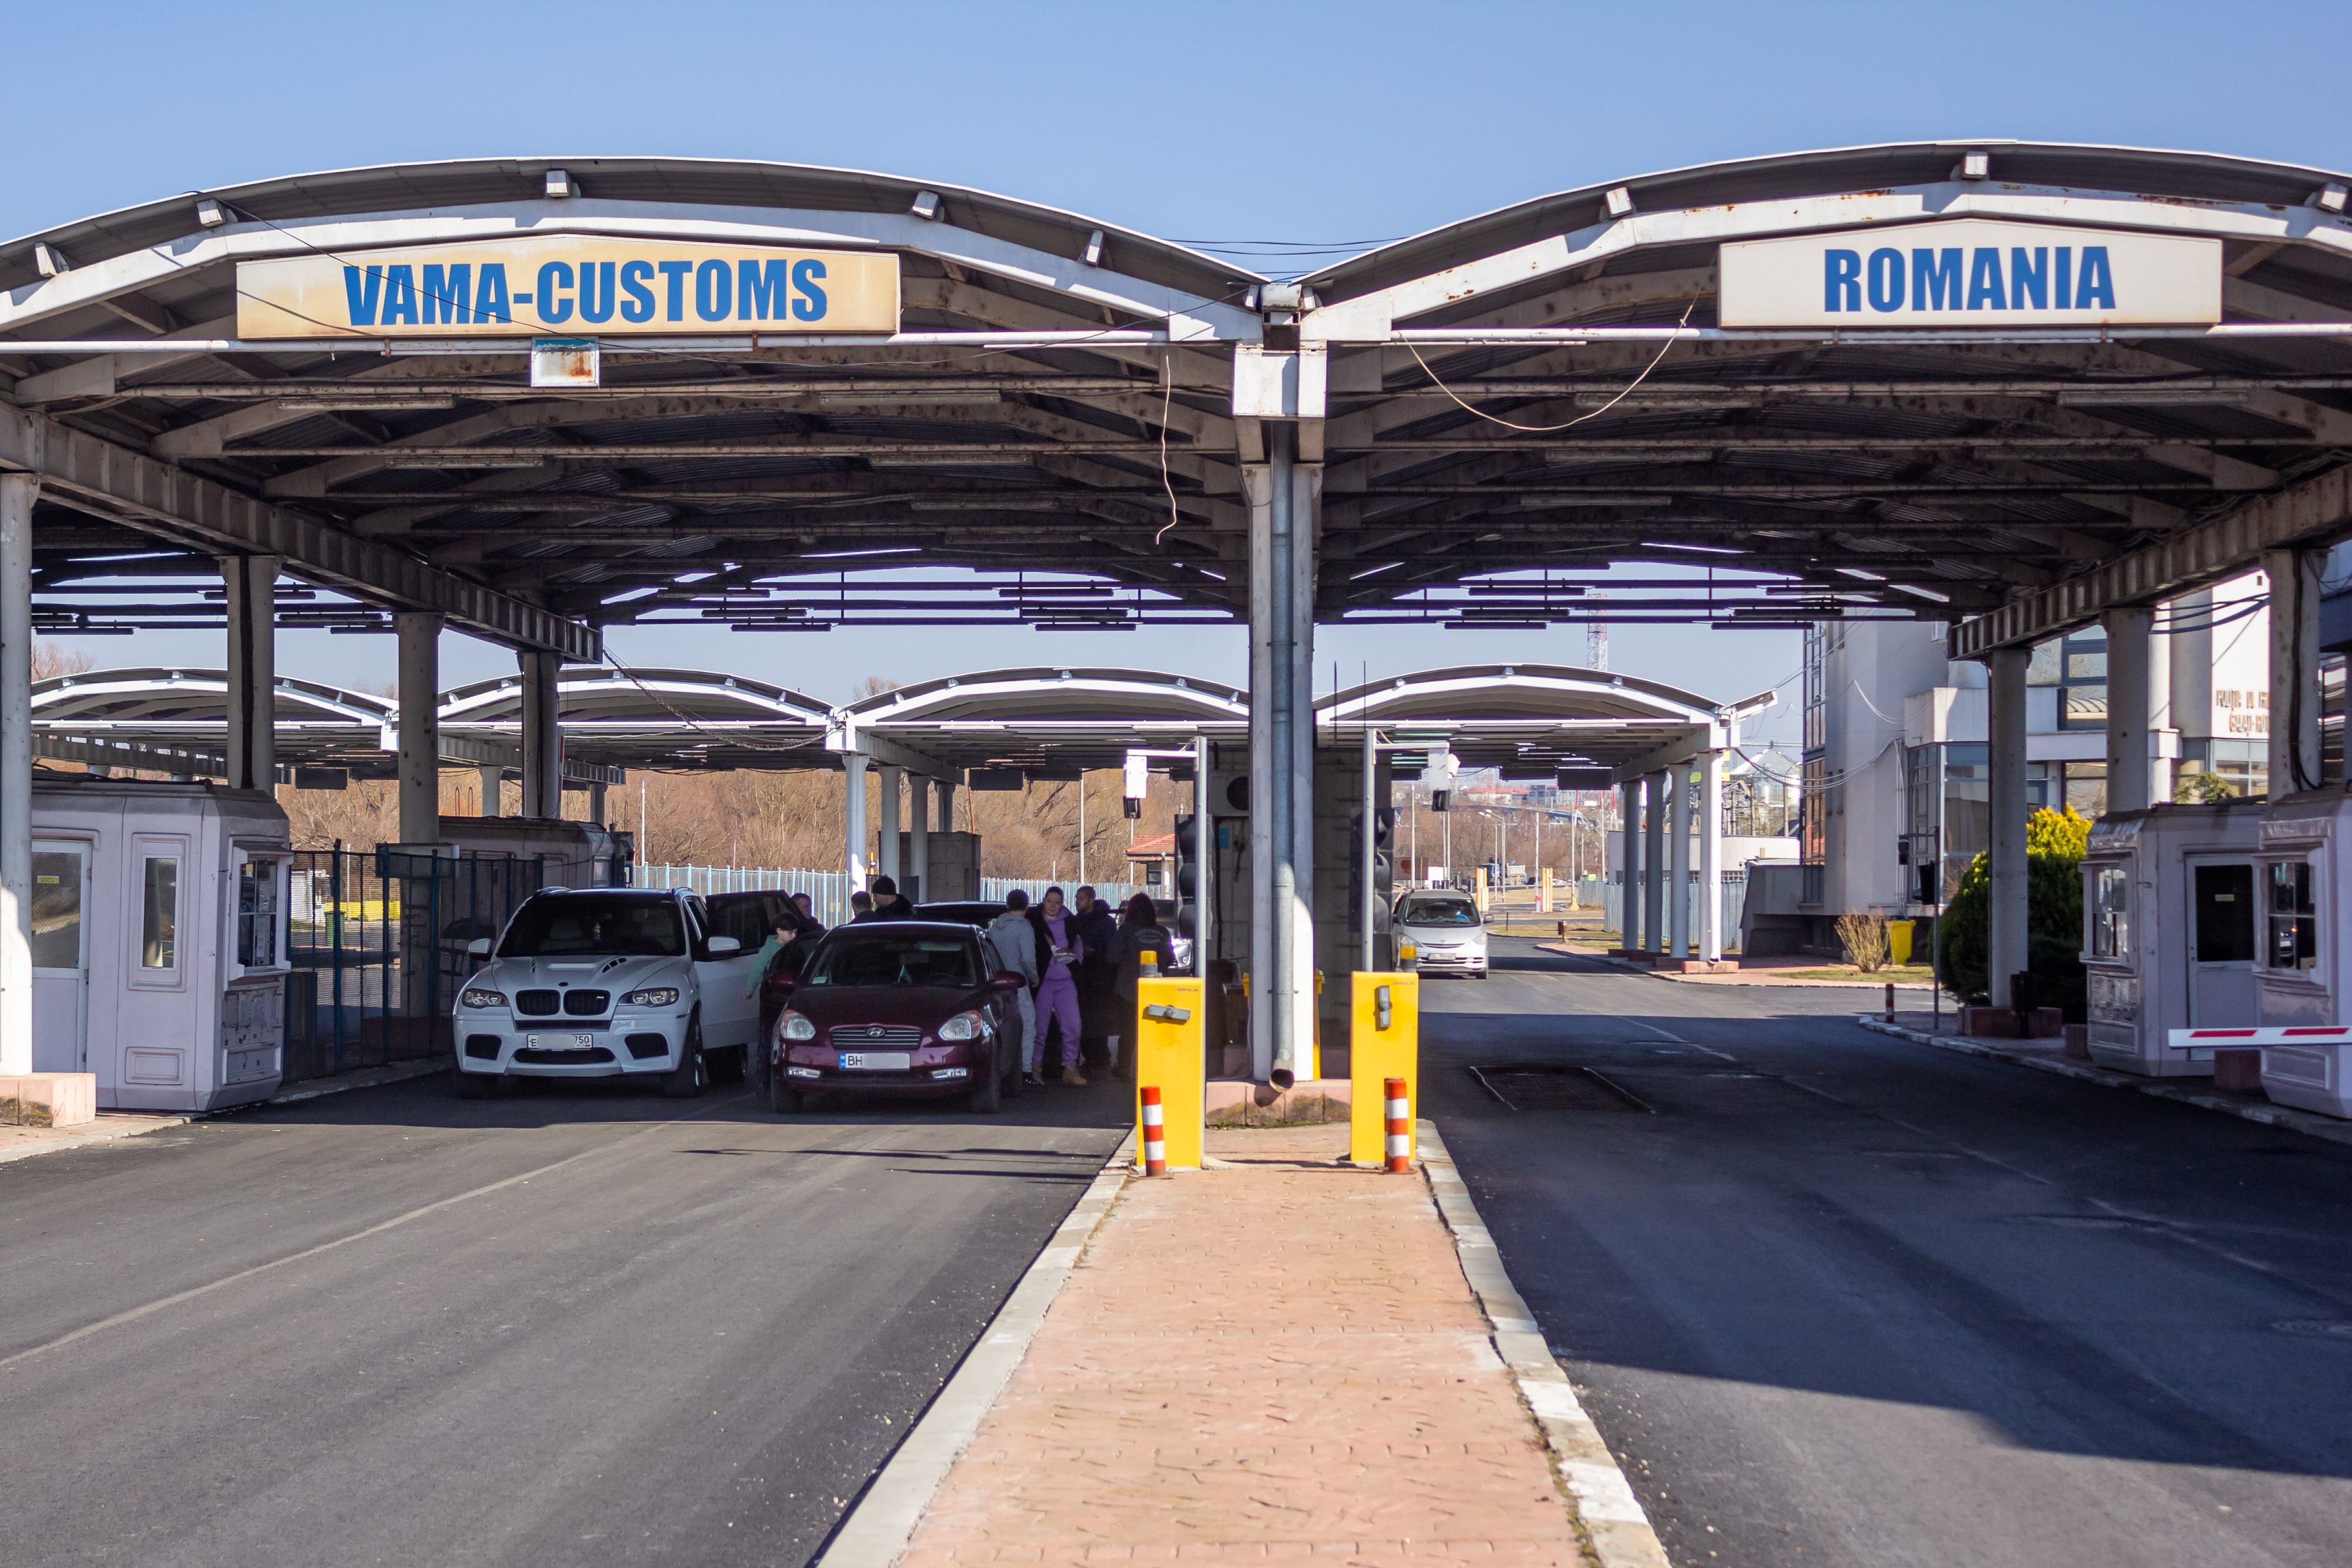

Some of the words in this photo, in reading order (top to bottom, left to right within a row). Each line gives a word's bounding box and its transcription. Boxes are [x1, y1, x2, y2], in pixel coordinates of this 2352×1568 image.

[344, 259, 828, 327] VAMA-CUSTOMS
[1824, 246, 2116, 313] ROMANIA
[531, 1038, 537, 1046] E
[847, 1055, 862, 1066] BH
